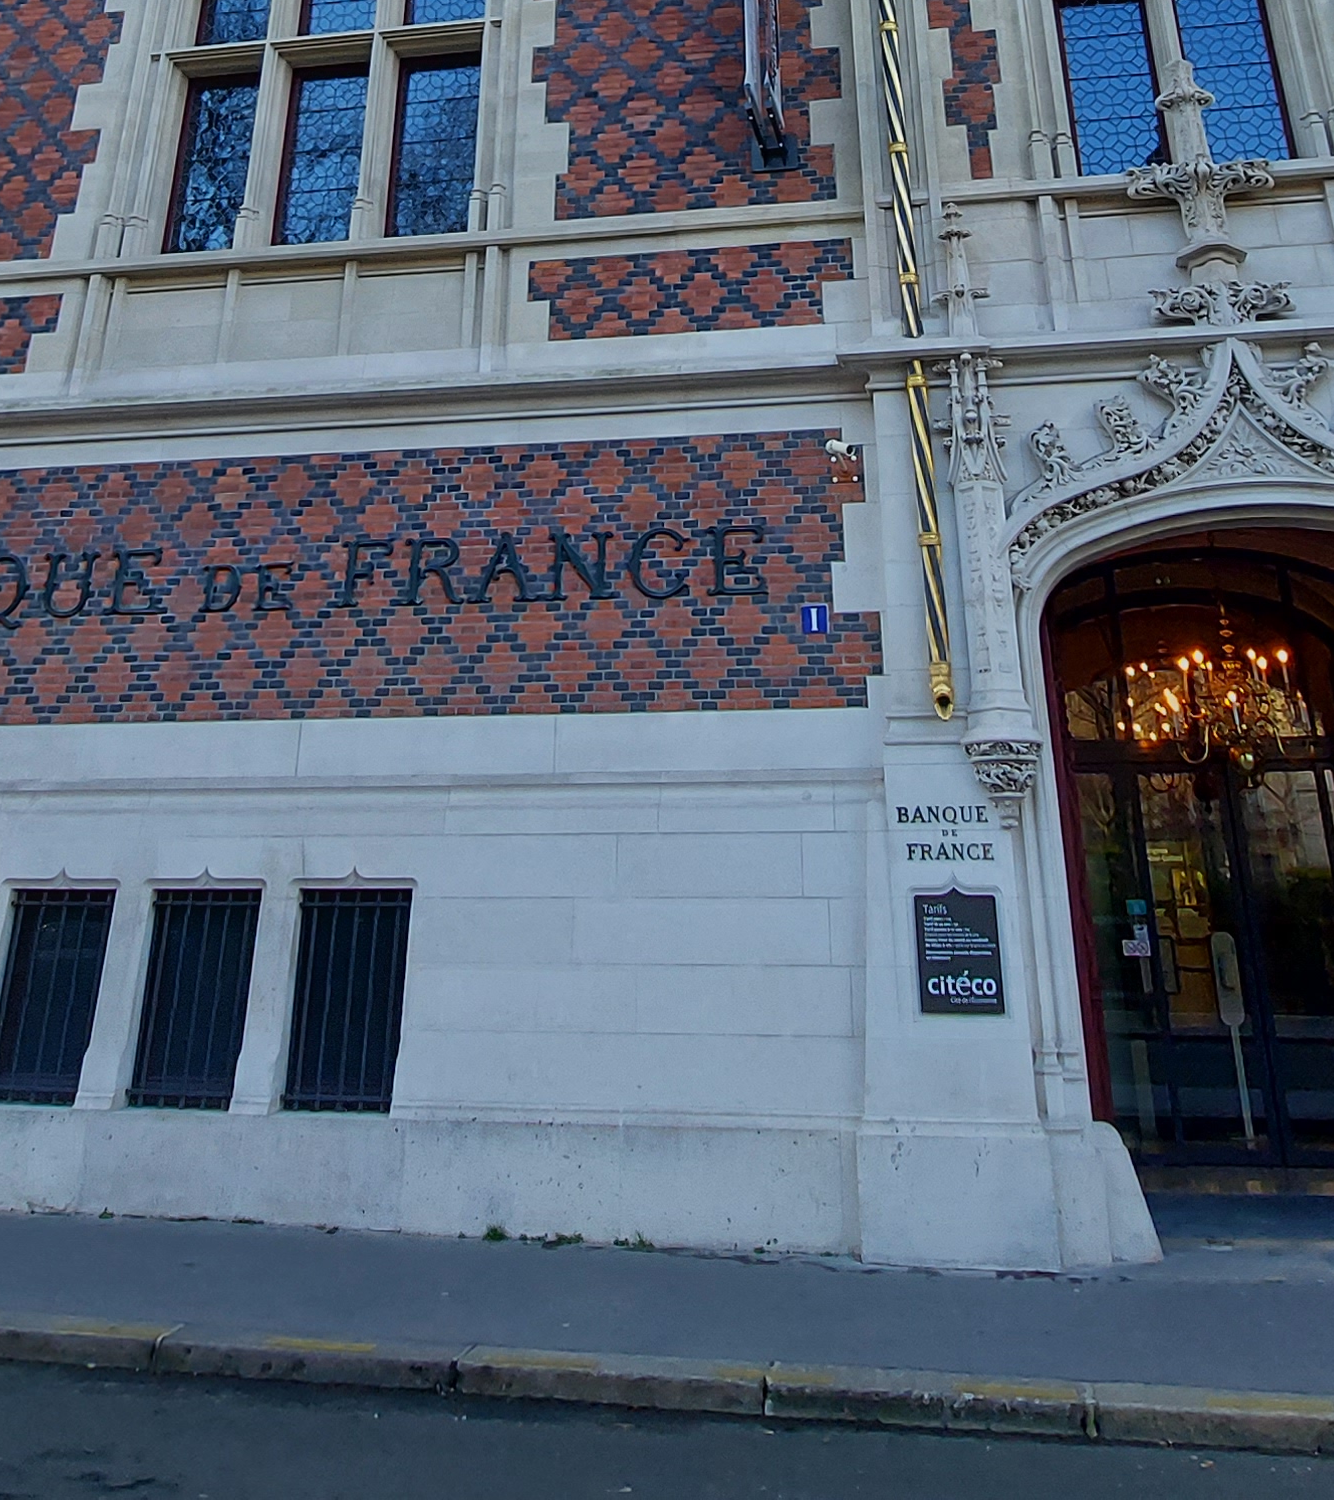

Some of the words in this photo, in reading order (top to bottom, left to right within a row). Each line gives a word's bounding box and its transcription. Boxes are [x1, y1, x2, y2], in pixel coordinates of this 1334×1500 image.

[197, 560, 296, 613] DE
[325, 525, 769, 609] FRANCE
[895, 805, 989, 825] BANQUE
[941, 829, 958, 838] DE
[906, 842, 995, 861] FRANCE
[922, 904, 947, 915] Tarifs
[927, 969, 997, 996] citéco
